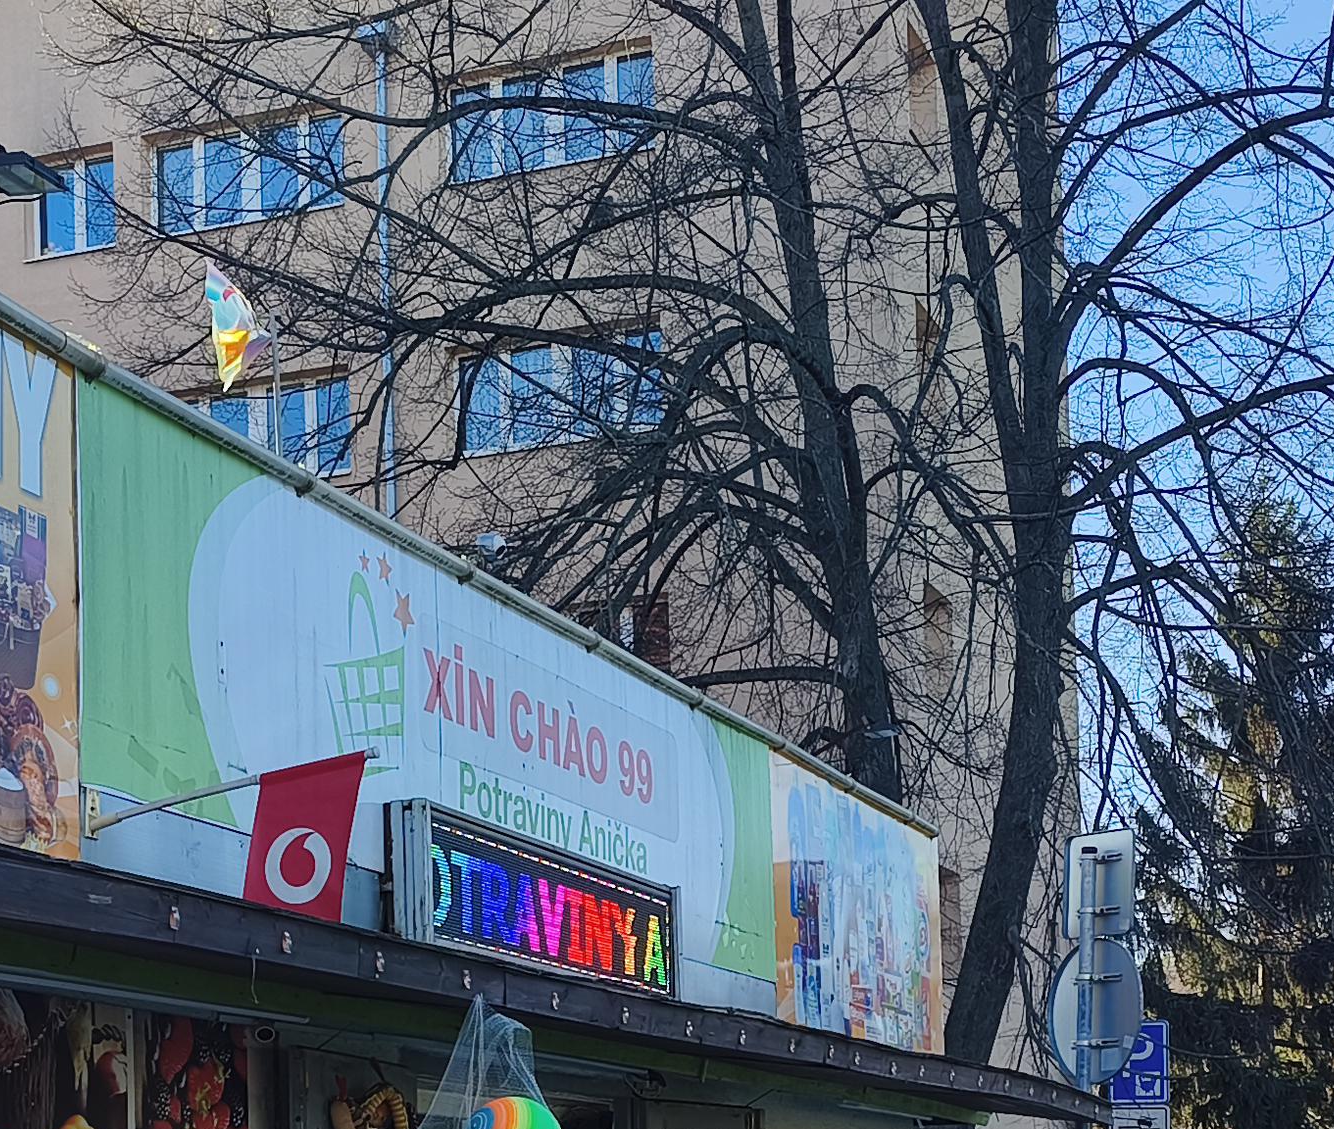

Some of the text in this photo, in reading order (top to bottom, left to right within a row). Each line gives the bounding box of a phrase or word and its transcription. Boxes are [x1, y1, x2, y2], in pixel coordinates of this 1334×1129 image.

[510, 690, 608, 785] CHÀO
[618, 740, 654, 804] 99
[459, 761, 648, 875] Potraviny Anička
